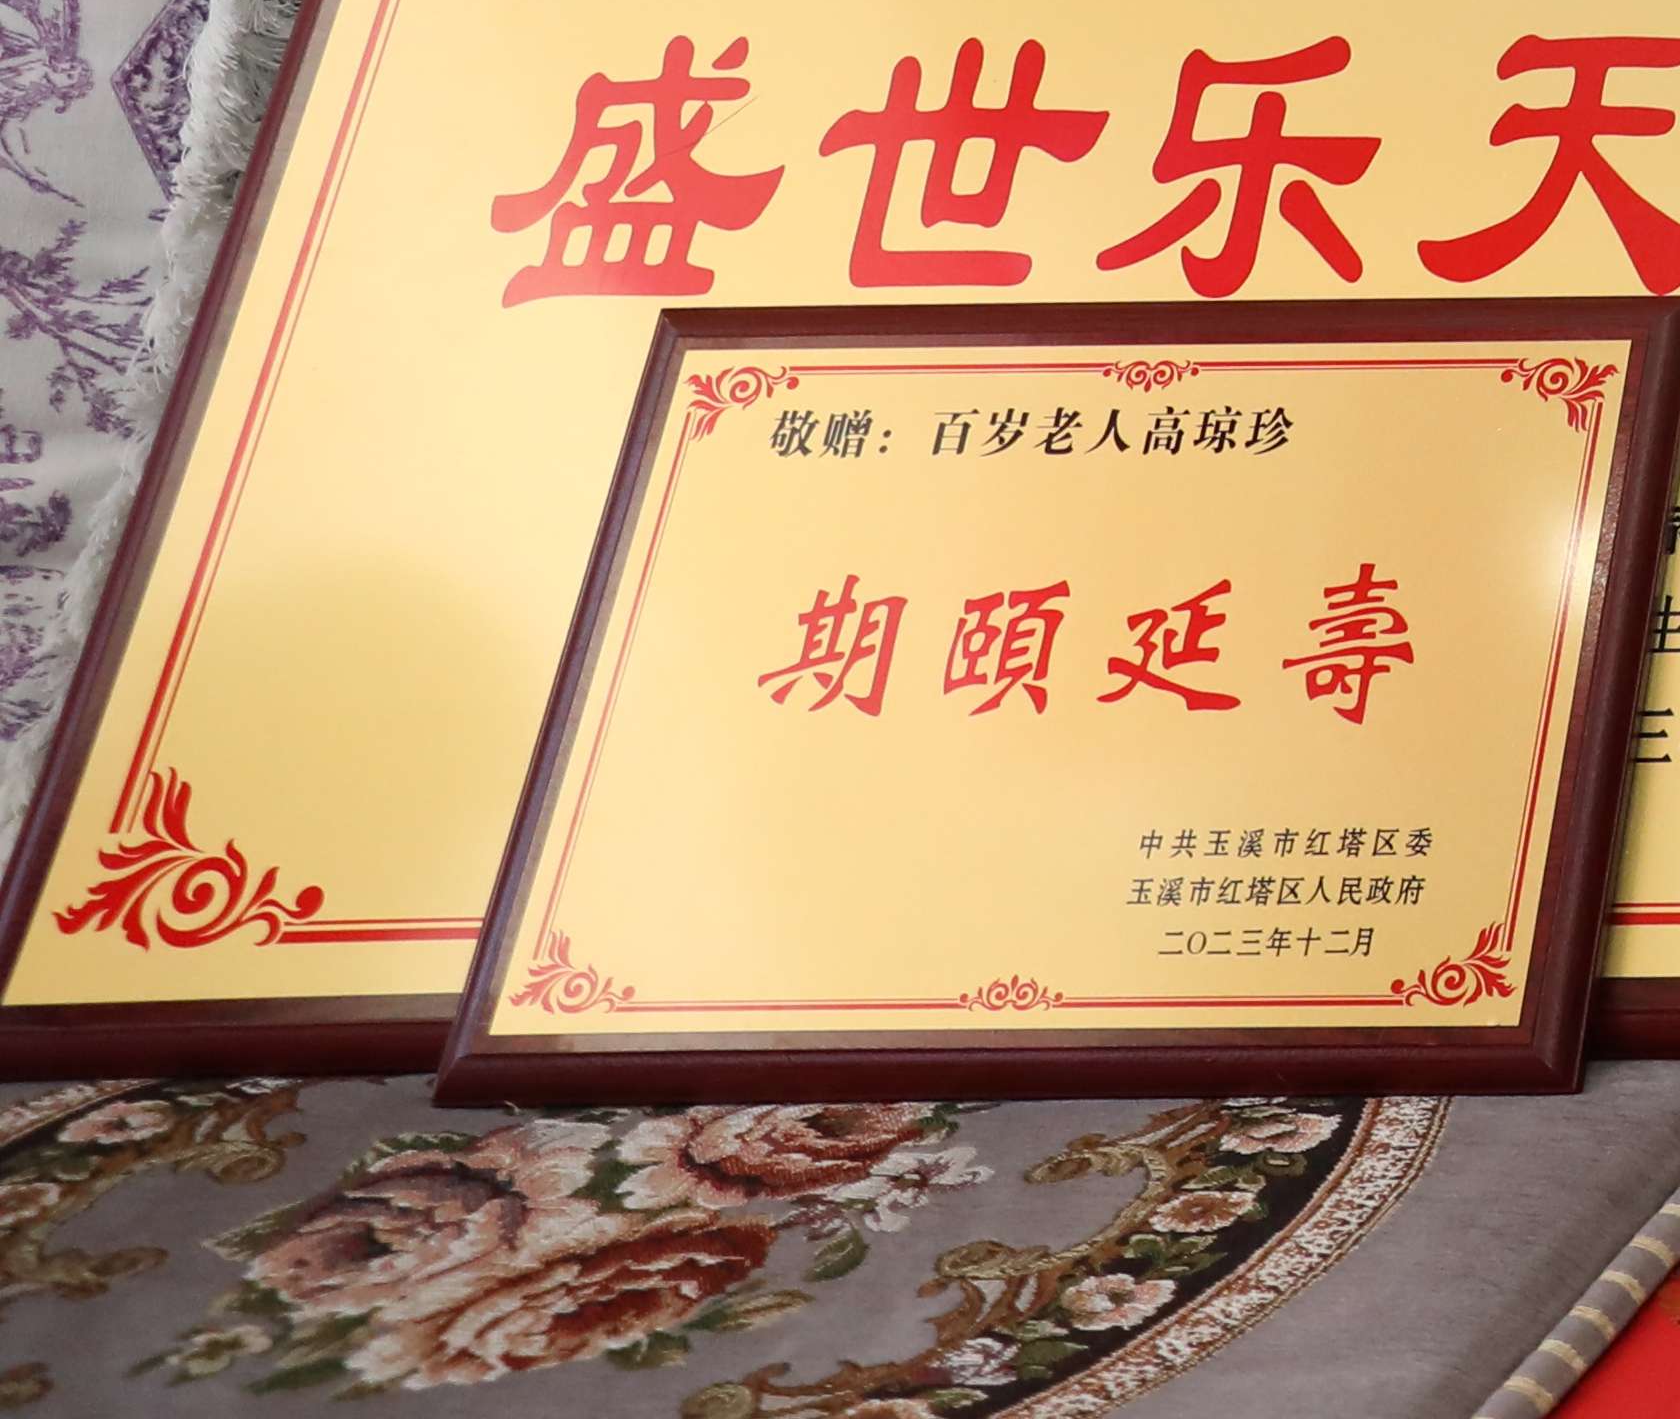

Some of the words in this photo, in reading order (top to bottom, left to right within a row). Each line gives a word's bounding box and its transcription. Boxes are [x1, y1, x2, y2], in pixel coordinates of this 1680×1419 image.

[1138, 827, 1433, 860] 中共玉溪市红塔区委
[1126, 875, 1426, 907] 玉溪市红塔区人民政府
